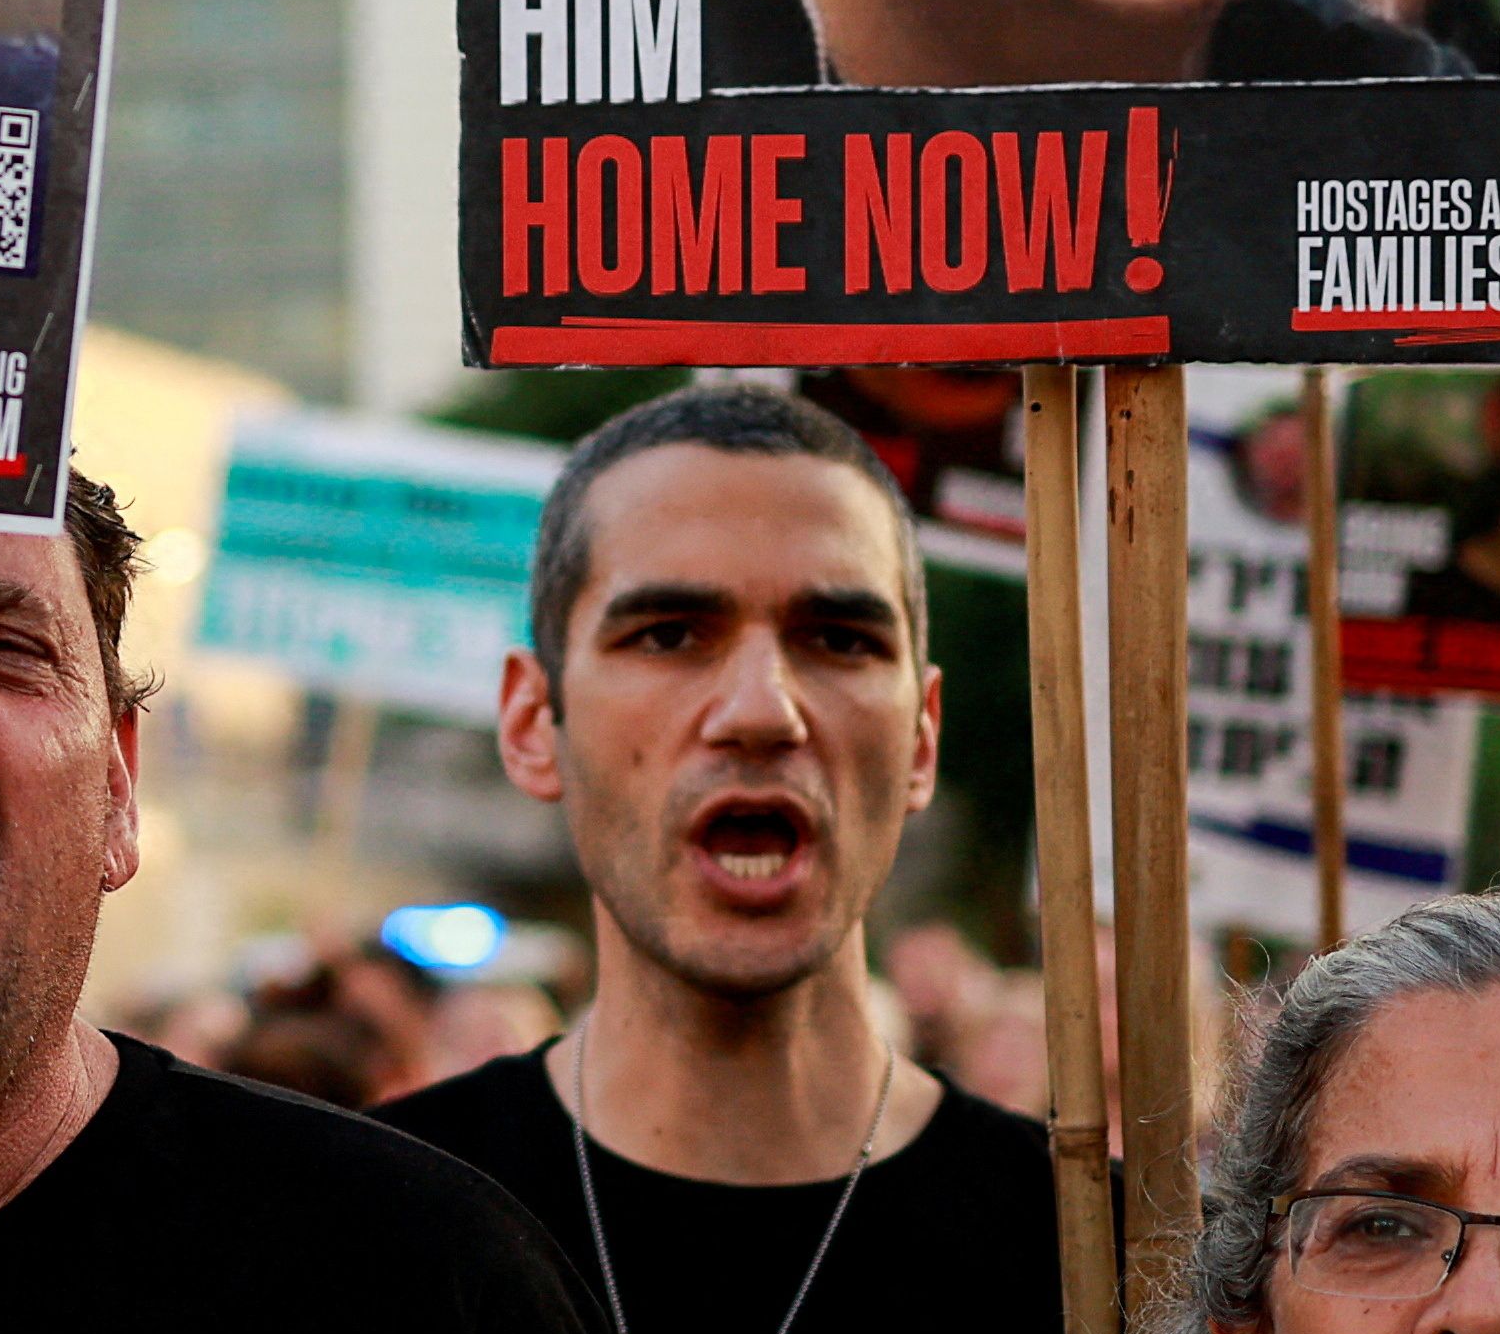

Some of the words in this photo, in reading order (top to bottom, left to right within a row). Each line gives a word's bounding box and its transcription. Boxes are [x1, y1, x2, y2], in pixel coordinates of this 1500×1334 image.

[500, 132, 807, 298] HOME
[844, 105, 1179, 296] NOW!
[1295, 177, 1474, 232] HOSTAGES
